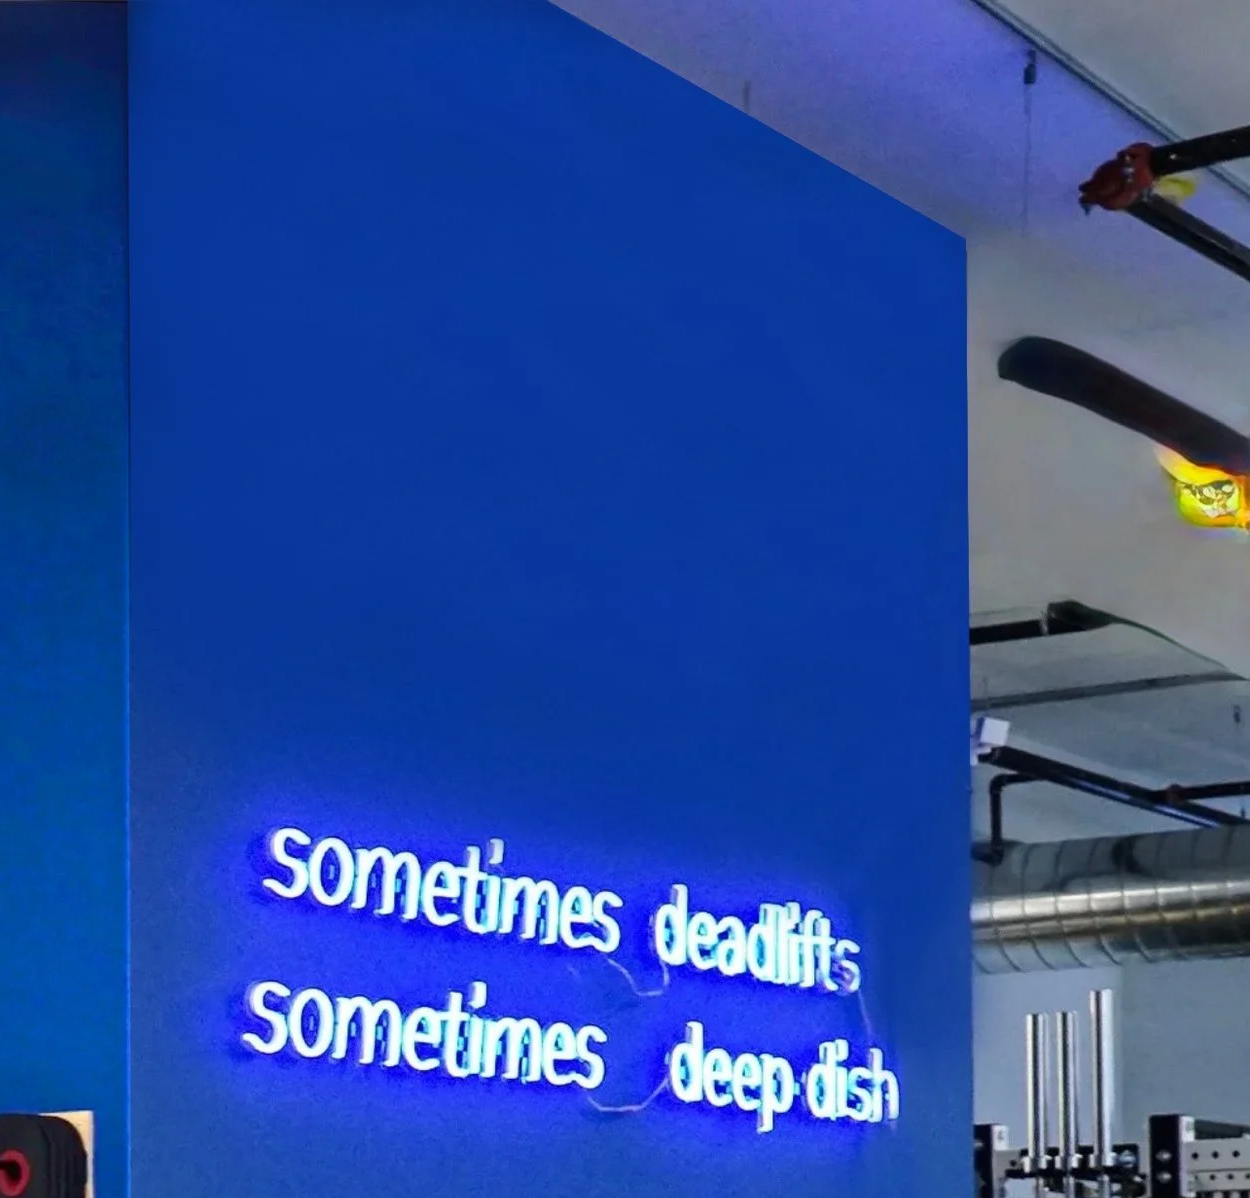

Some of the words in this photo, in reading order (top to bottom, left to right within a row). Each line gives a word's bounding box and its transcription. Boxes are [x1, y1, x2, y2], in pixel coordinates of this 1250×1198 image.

[263, 827, 622, 953] sometimes
[654, 883, 861, 994] deadlifts
[242, 980, 607, 1090] sometimes
